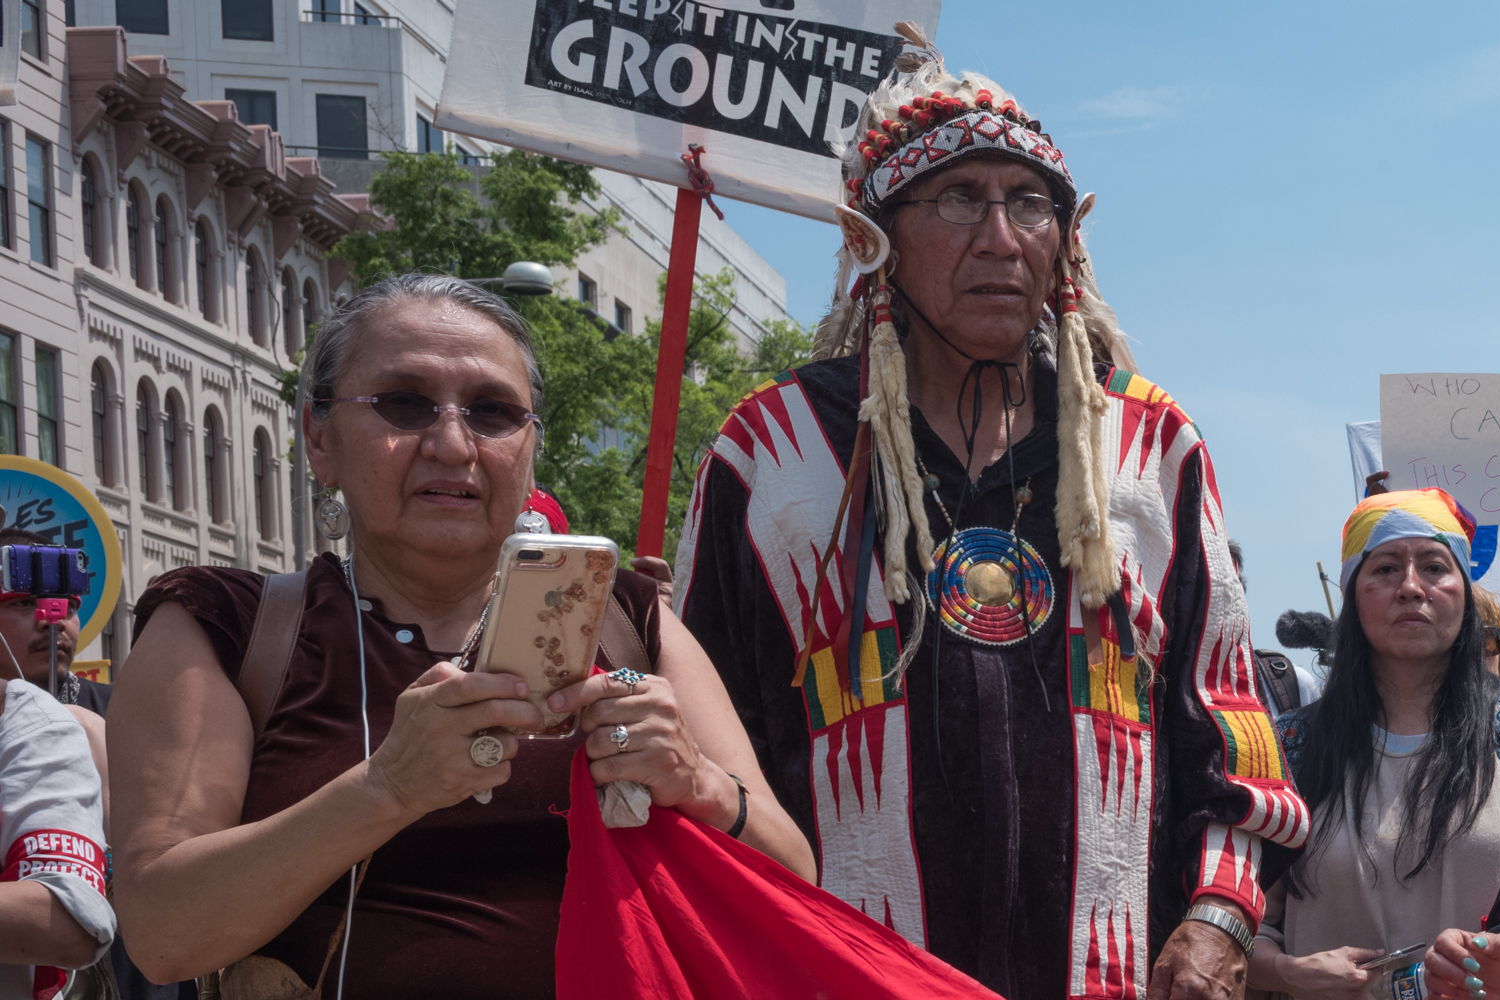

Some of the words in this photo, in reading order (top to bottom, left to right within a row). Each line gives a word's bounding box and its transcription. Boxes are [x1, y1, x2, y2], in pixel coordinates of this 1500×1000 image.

[683, 1, 724, 36] IT
[735, 14, 785, 53] IN
[797, 29, 881, 79] THE
[548, 79, 562, 88] ART
[564, 83, 572, 91] BY
[574, 86, 594, 97] ISAAC
[551, 19, 868, 141] GROUND
[1405, 376, 1480, 397] WHO
[1408, 457, 1467, 490] THIS
[23, 833, 96, 863] DEFEND
[18, 860, 100, 892] PROTECT
